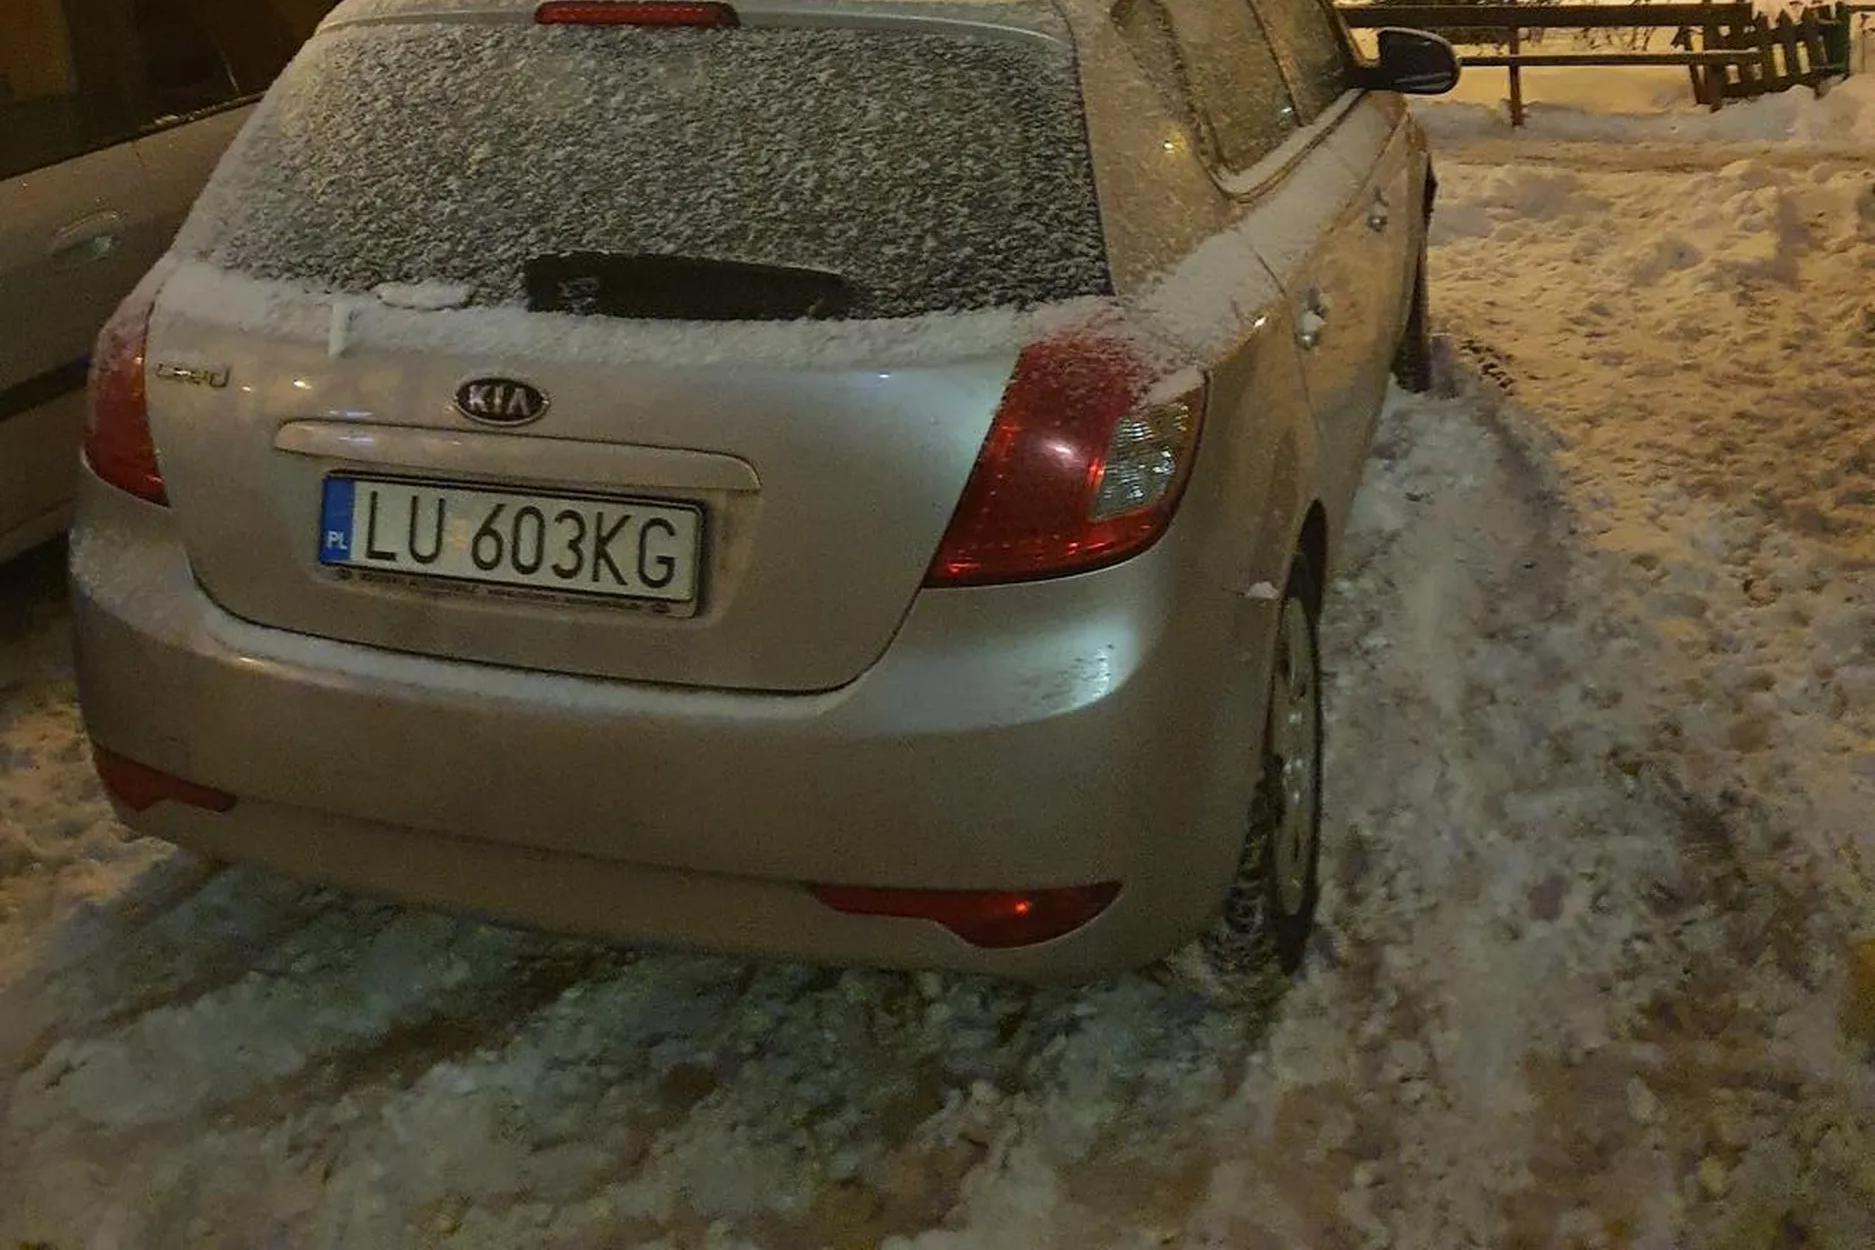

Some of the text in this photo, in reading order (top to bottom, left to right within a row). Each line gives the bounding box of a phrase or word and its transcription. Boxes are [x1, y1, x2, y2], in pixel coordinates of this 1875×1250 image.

[468, 384, 531, 416] KIA
[327, 530, 348, 550] PL
[366, 490, 677, 589] LU 603KG
